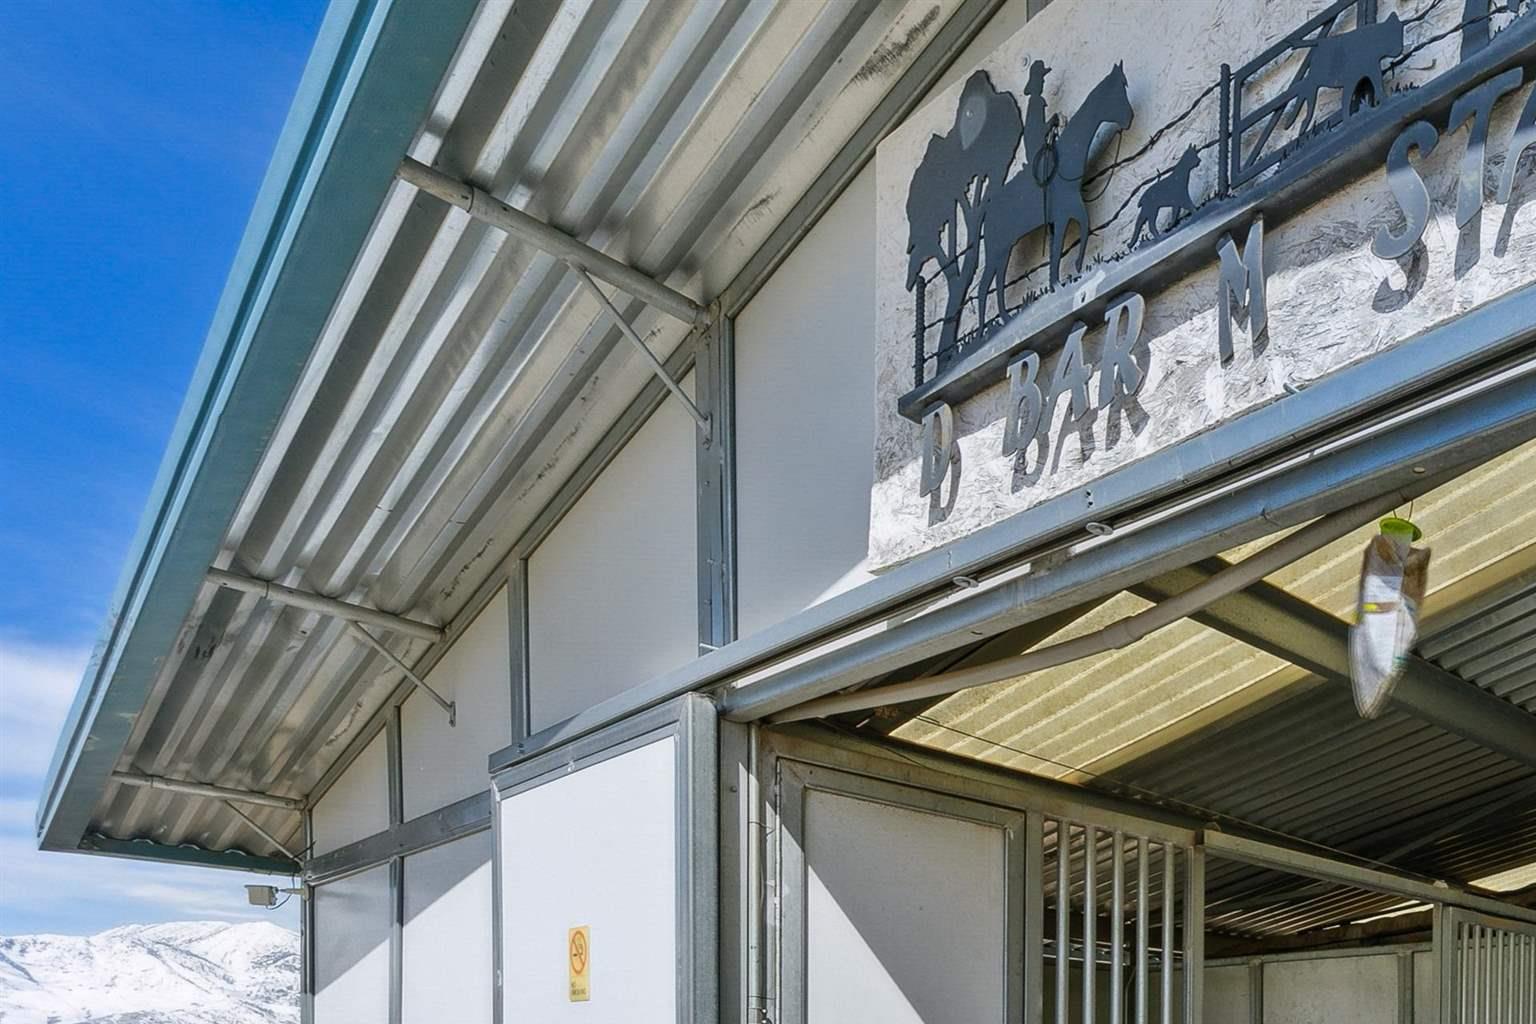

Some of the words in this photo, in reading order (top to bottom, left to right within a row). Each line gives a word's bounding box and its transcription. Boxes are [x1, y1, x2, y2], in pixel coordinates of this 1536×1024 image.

[919, 401, 954, 498] D
[1001, 291, 1147, 458] BAR
[1216, 211, 1268, 368] M
